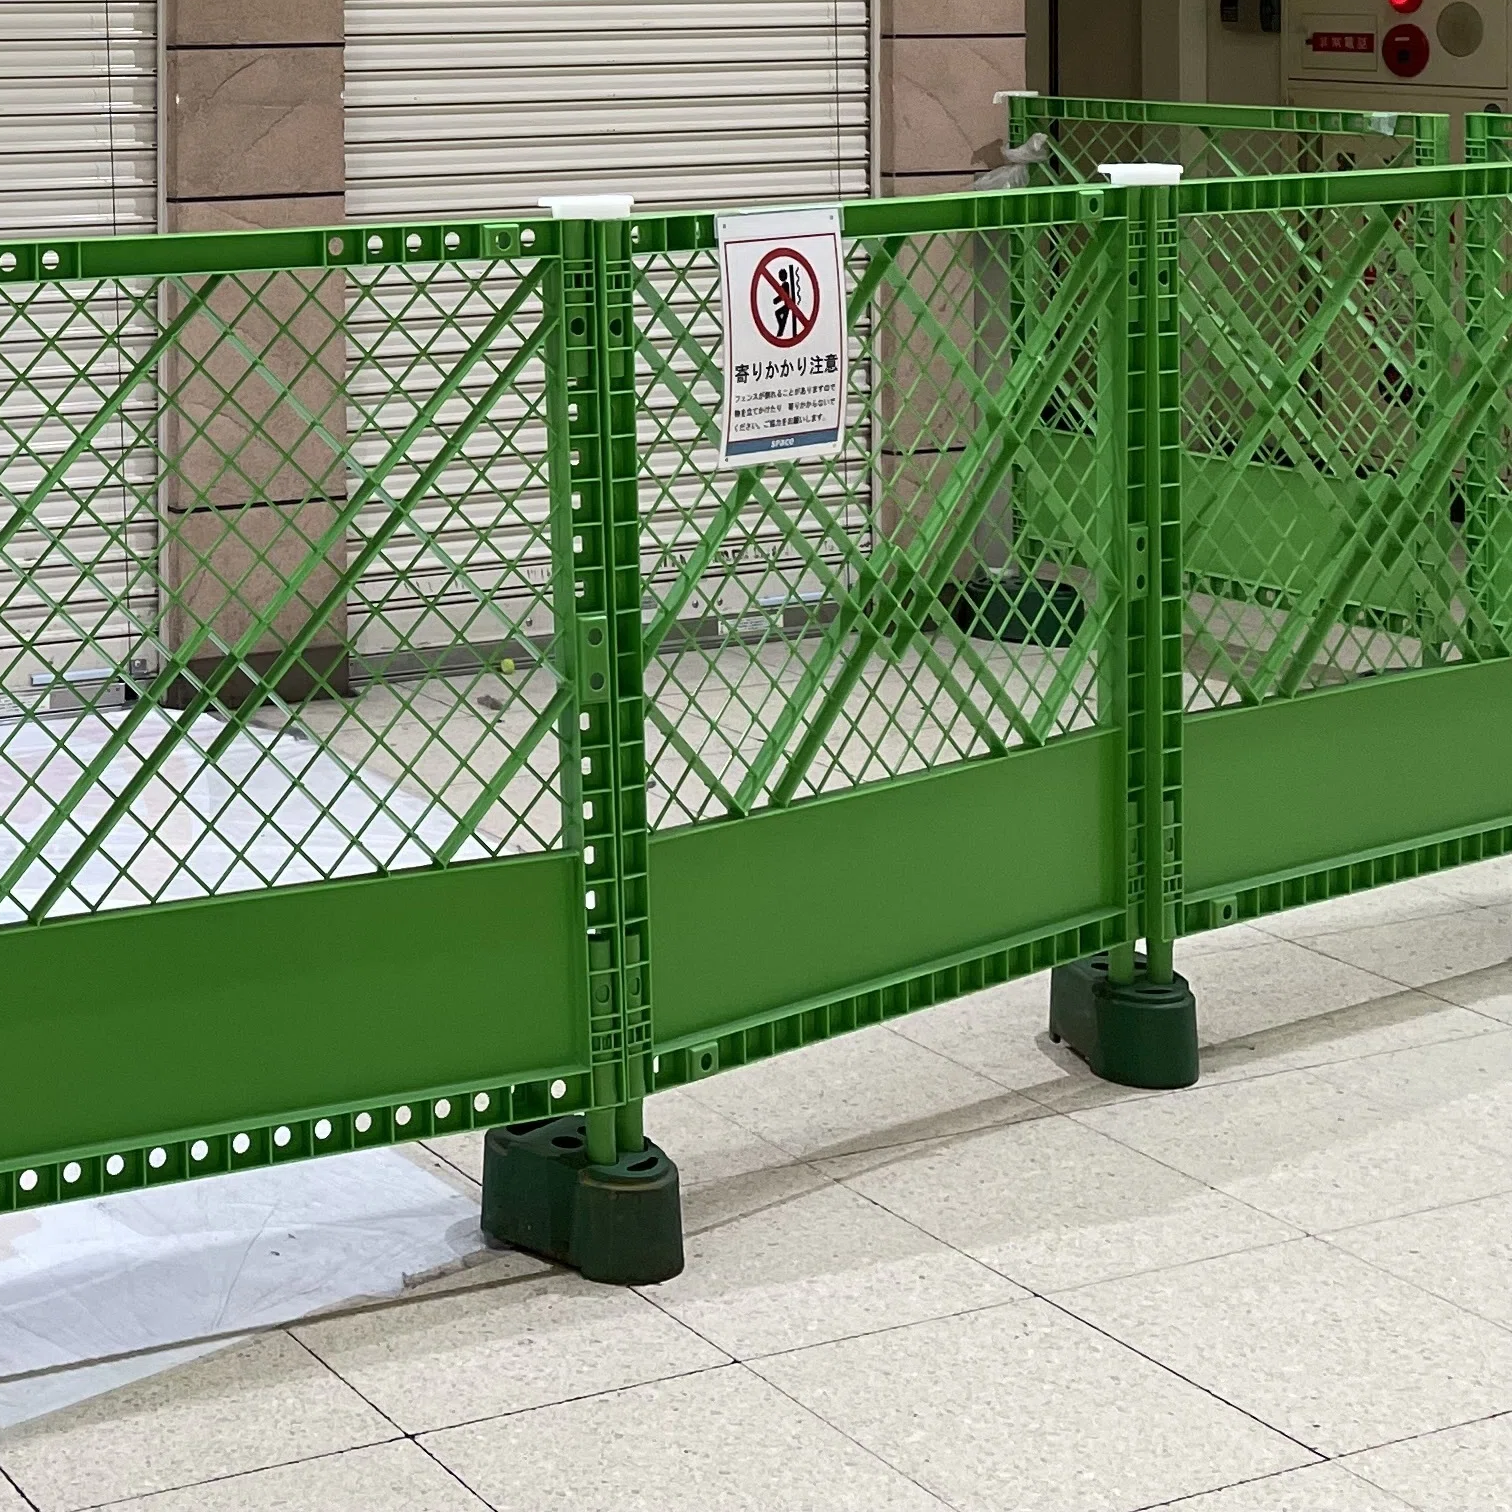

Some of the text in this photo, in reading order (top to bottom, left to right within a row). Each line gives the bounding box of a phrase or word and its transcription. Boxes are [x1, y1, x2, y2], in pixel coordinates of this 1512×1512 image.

[734, 353, 839, 384] 寄りかかり注意
